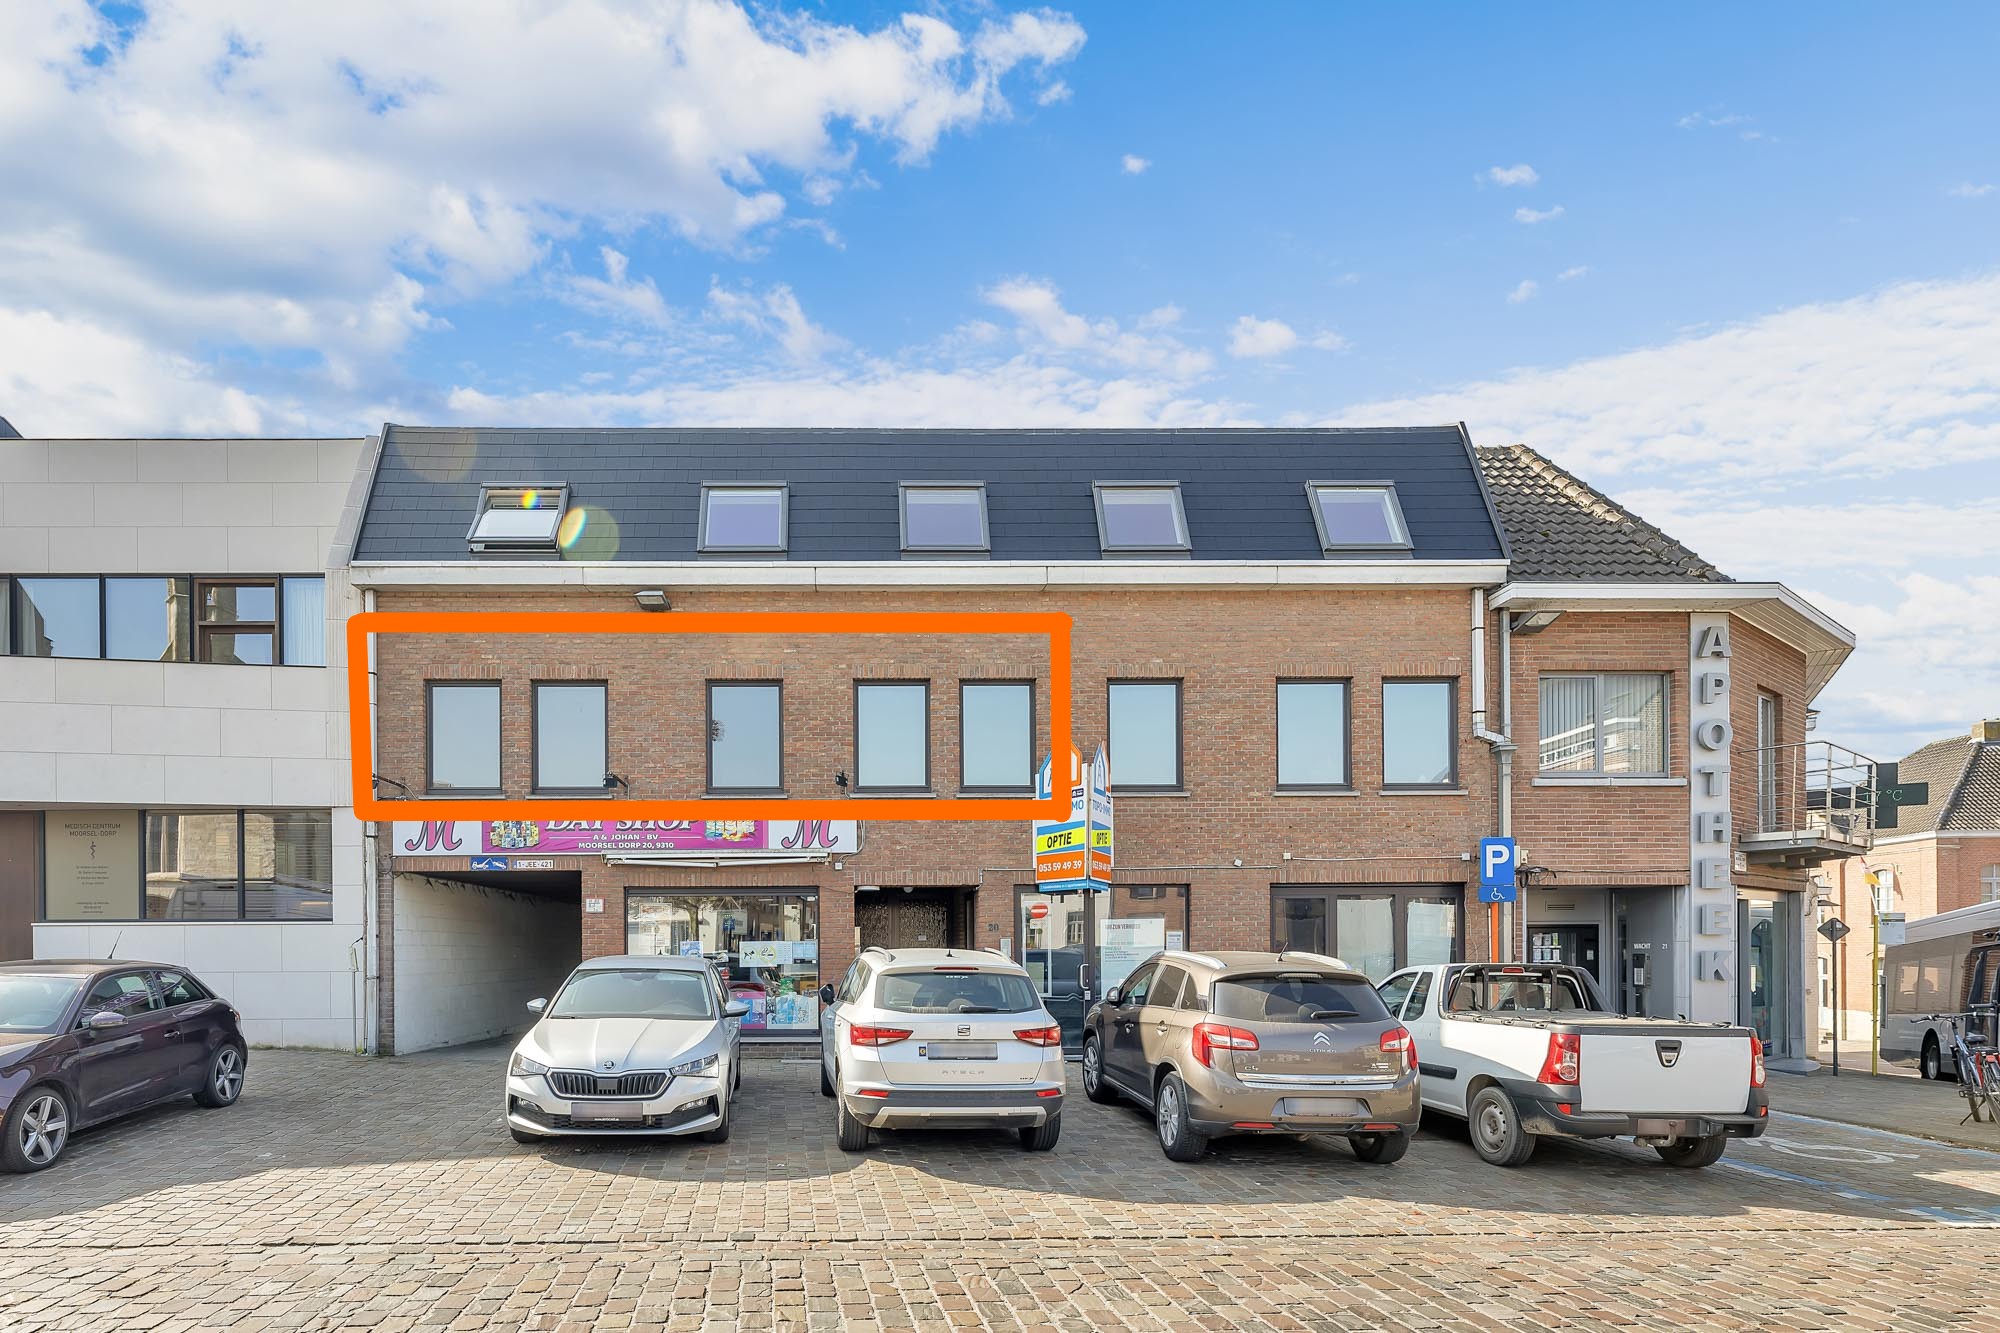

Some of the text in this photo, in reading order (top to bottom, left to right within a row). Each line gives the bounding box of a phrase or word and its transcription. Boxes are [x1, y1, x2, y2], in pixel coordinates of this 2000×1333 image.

[1698, 625, 1733, 981] APOTHEEK
[1046, 832, 1072, 849] OPTIE
[1038, 860, 1082, 872] 053 59 49 39
[1486, 844, 1510, 878] P
[988, 923, 999, 932] 20
